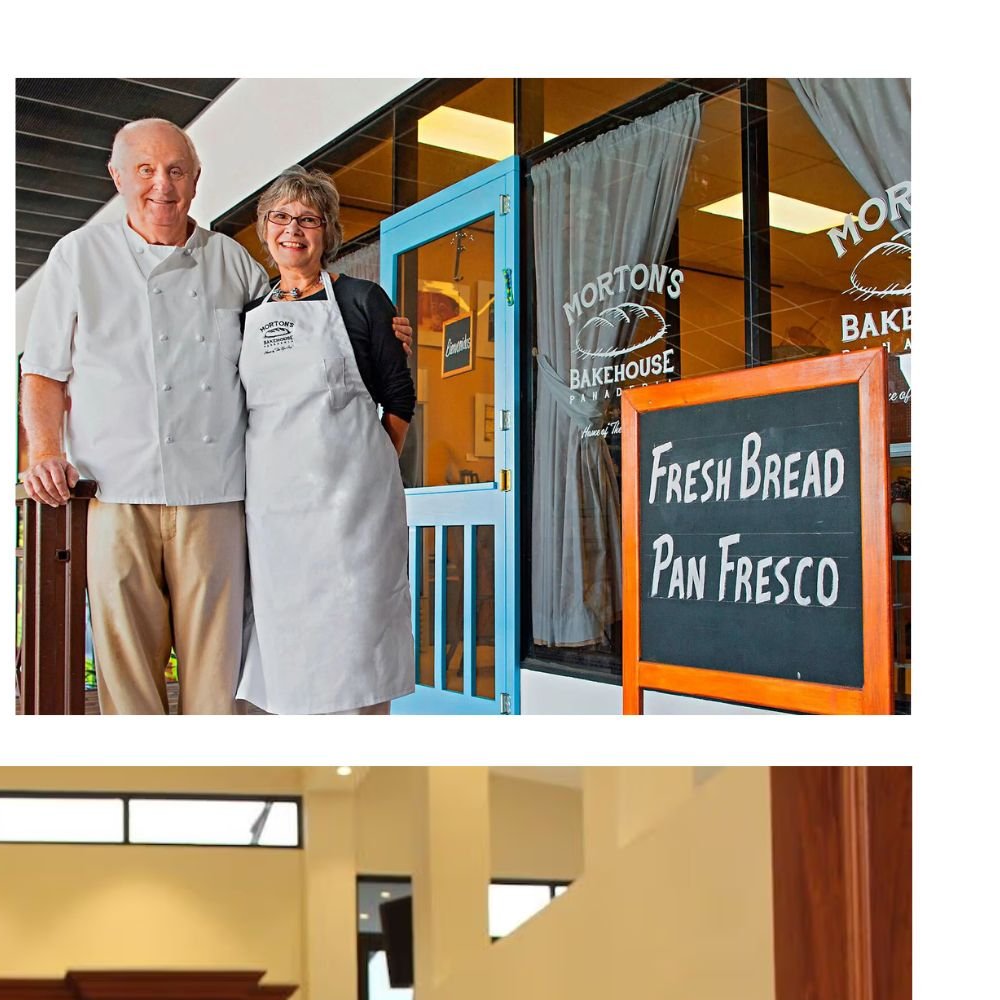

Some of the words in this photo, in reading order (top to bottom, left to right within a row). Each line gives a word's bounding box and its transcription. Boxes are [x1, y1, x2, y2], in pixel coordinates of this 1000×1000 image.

[827, 180, 911, 258] MOR
[562, 263, 684, 326] MORTON'S
[569, 349, 675, 390] BAKEHOUSE
[648, 441, 732, 504] FRESH
[739, 431, 845, 501] BREAD
[650, 533, 707, 600] PAN
[717, 533, 840, 607] FRESCO
